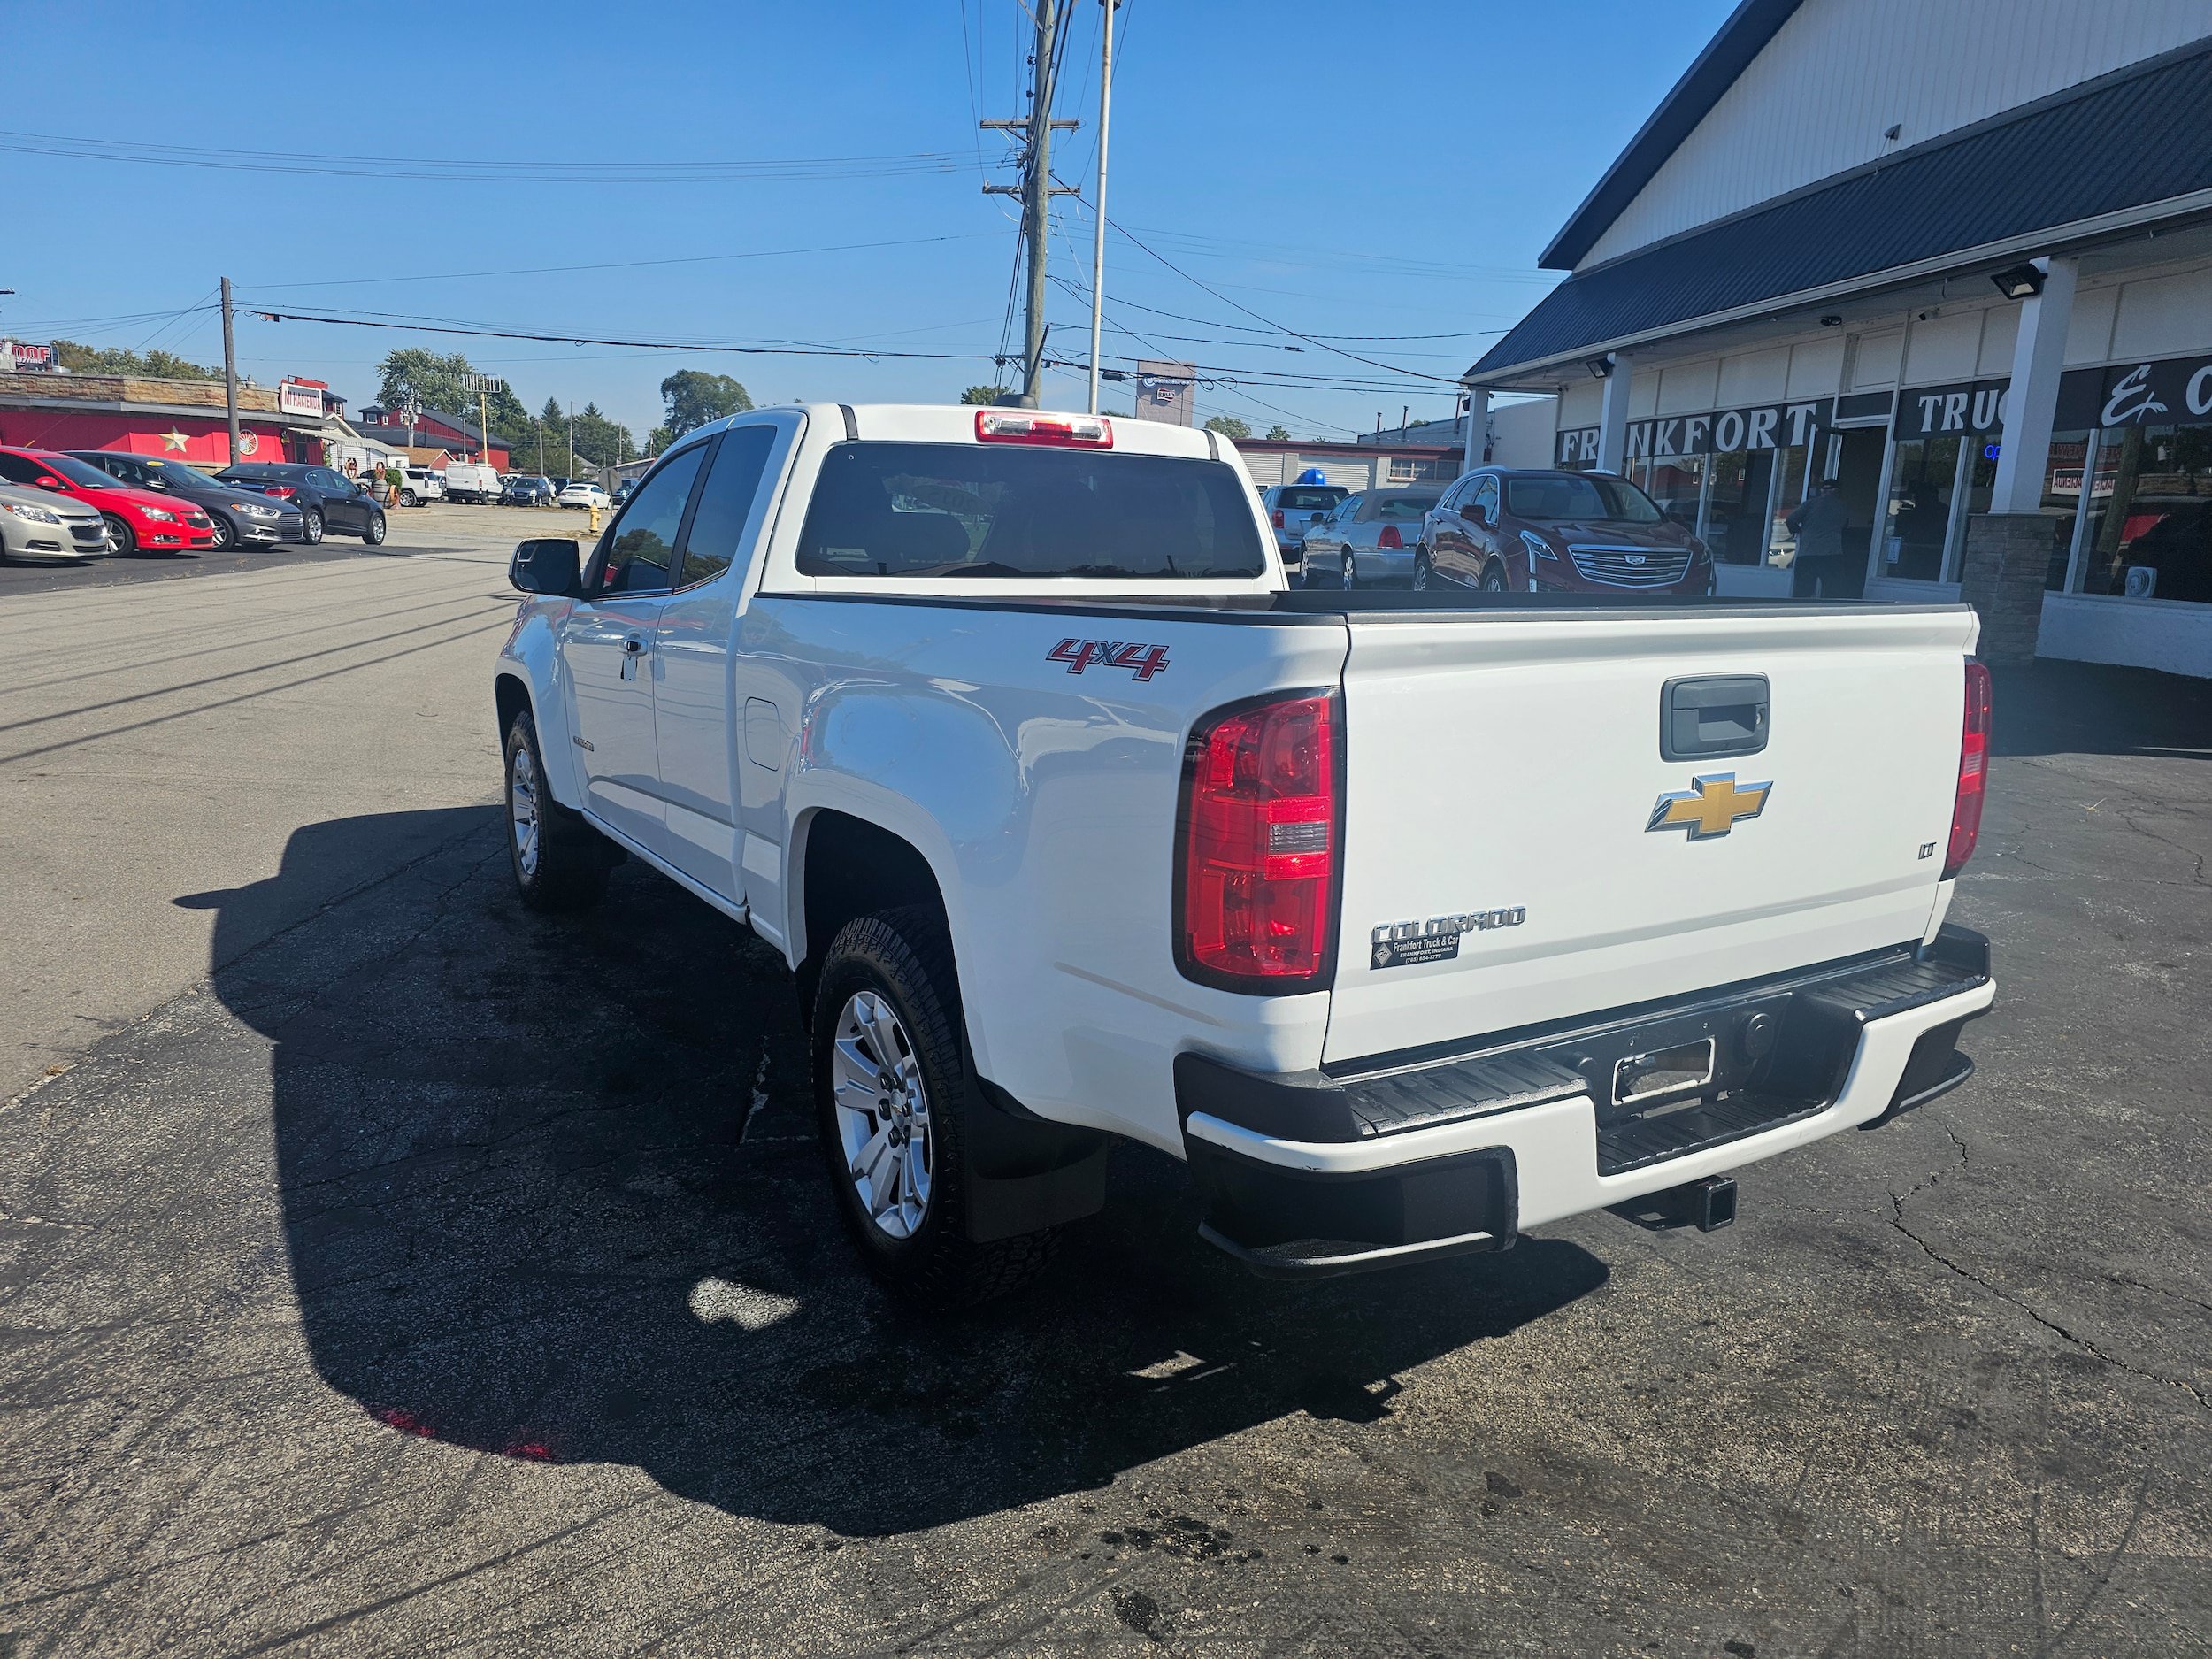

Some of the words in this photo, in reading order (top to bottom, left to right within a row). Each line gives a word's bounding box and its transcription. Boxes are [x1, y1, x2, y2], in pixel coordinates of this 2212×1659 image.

[12, 345, 50, 361] OOF
[285, 390, 292, 406] MI
[293, 391, 321, 410] HACIENDA
[1561, 403, 1817, 463] FRNKFORT
[2101, 364, 2168, 426] &
[1918, 841, 1937, 860] LT
[1371, 906, 1526, 944] COLORADO
[1393, 939, 1422, 952] Frankfort
[1423, 936, 1441, 949] Truck
[1441, 936, 1448, 946] &
[1448, 934, 1459, 946] Car
